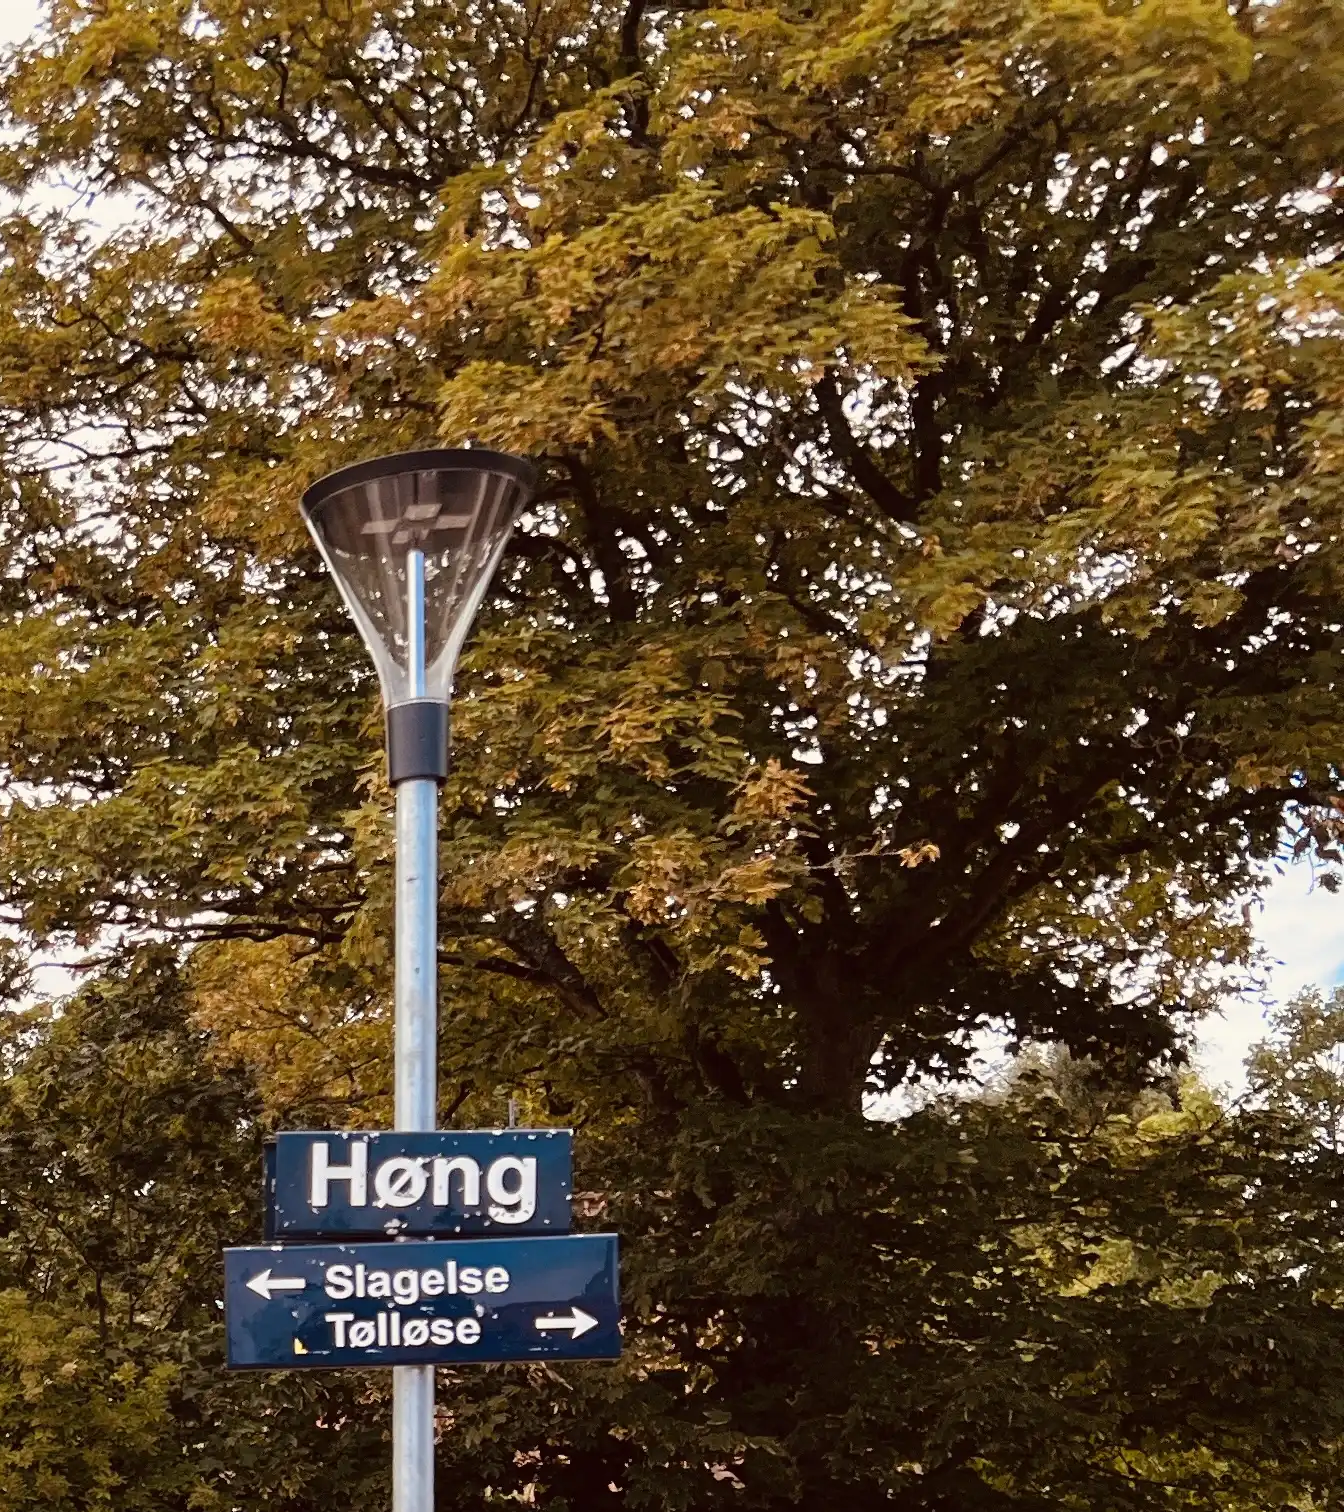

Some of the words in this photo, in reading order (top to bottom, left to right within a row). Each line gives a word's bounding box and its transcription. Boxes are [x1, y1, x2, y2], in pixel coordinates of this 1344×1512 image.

[311, 1141, 538, 1224] Høng
[324, 1259, 510, 1305] Slagelse
[324, 1311, 481, 1348] Tølløse
